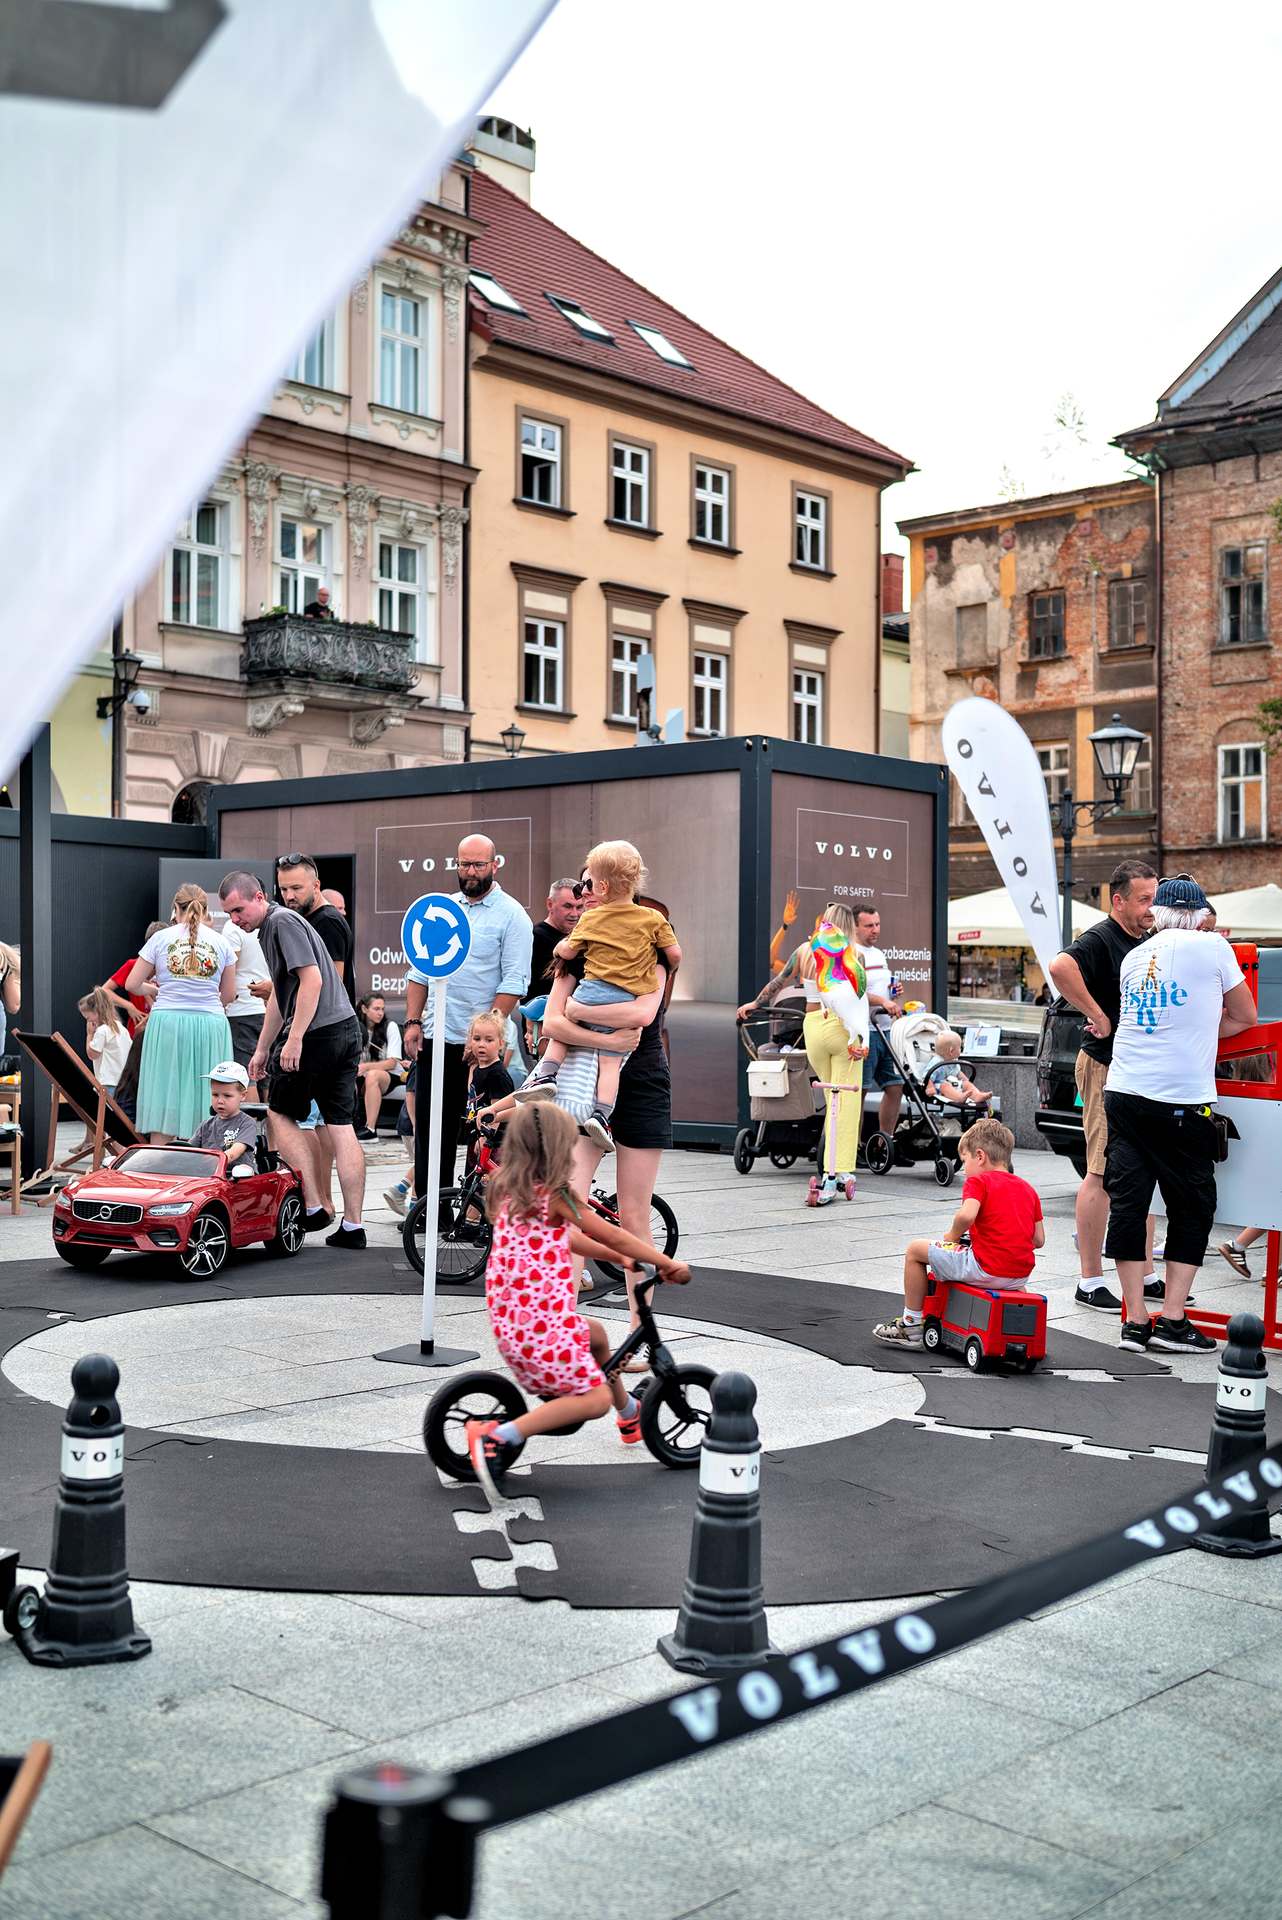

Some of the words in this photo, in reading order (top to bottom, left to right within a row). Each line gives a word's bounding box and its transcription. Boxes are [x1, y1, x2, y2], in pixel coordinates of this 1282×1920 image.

[815, 841, 892, 860] VOLVO
[398, 854, 506, 873] VOLO
[833, 885, 848, 896] FOR
[849, 886, 875, 898] SAFETY
[882, 945, 932, 961] zobaczenia
[371, 973, 408, 995] Bezp
[728, 1464, 759, 1478] VO
[1122, 1457, 1282, 1550] VOLVO
[667, 1613, 938, 1744] VOLVO
